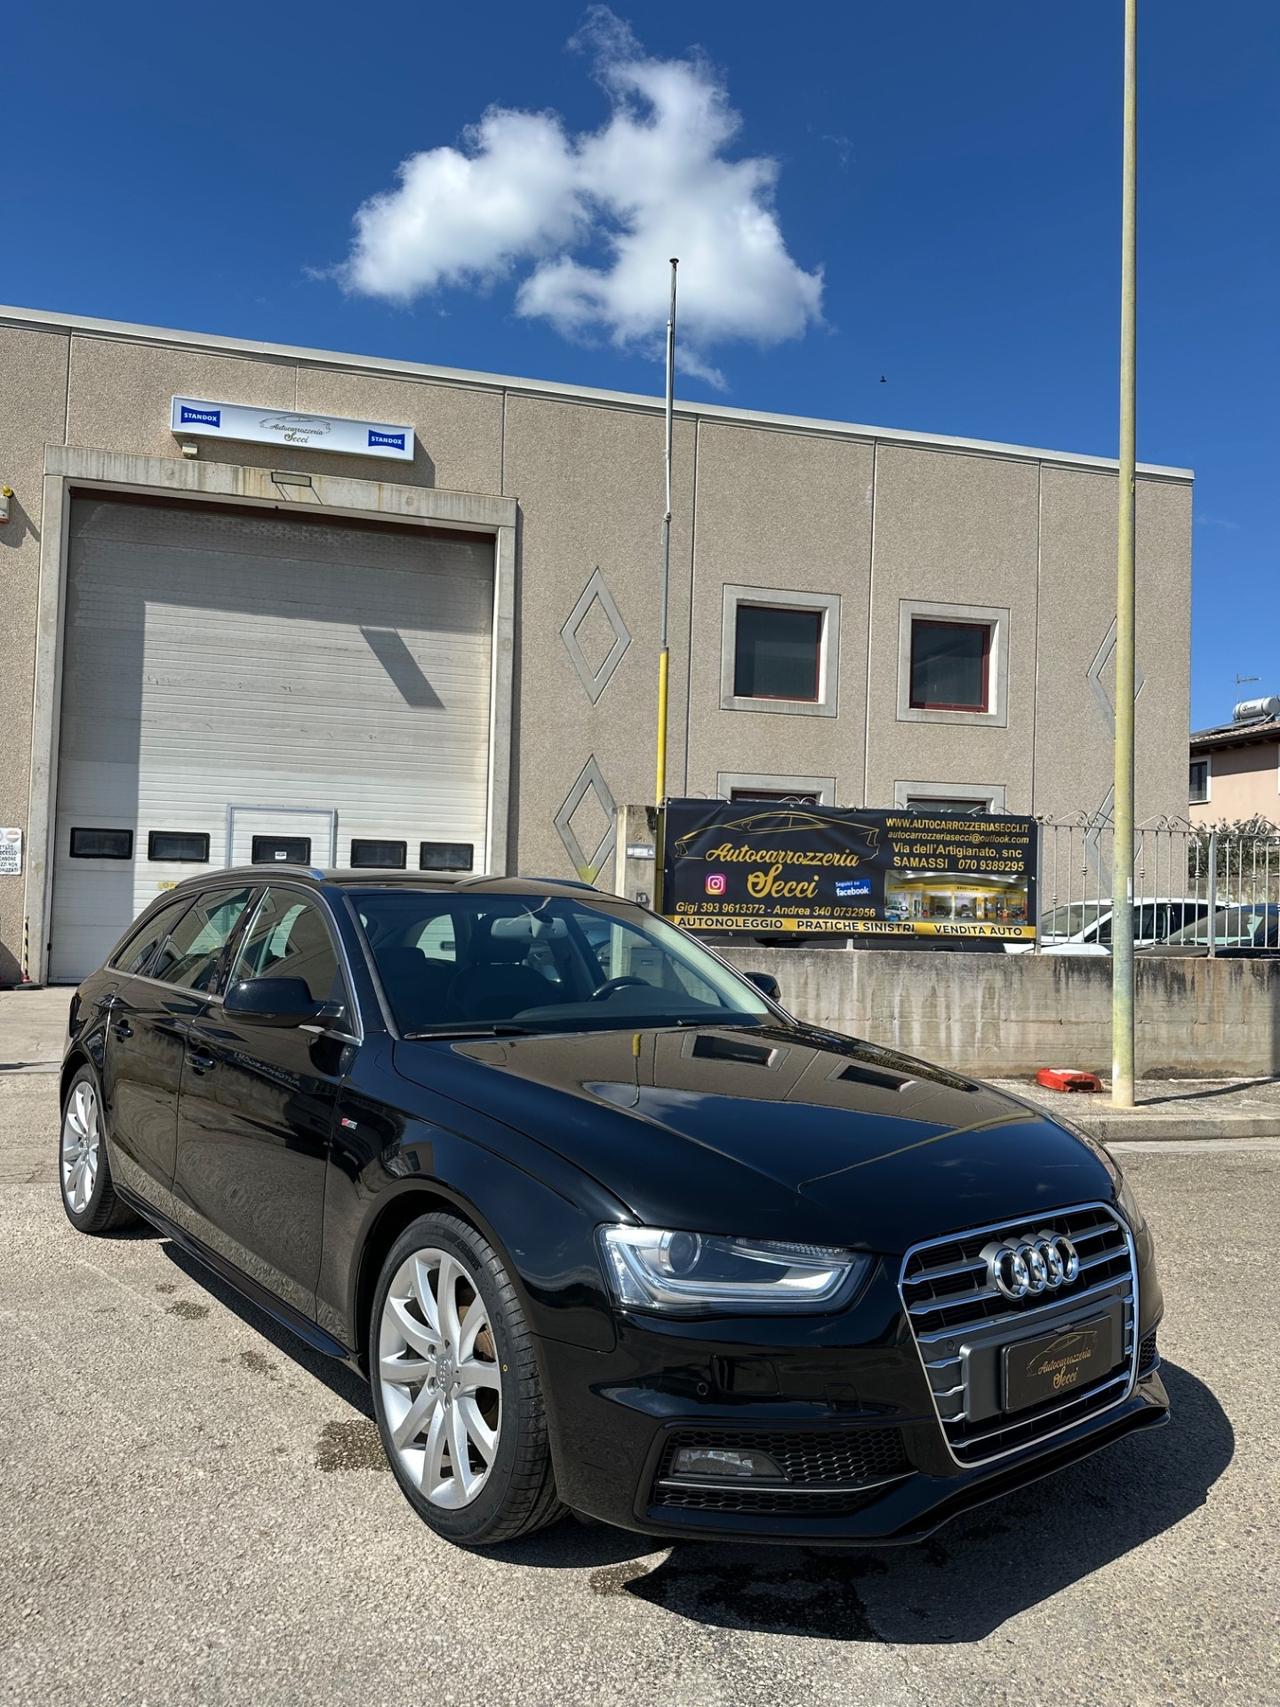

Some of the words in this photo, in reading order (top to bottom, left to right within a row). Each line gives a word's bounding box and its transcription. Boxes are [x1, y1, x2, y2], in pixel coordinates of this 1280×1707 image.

[183, 412, 217, 422] STANDOX
[371, 436, 402, 444] STANDOX
[885, 818, 1030, 833] WWW.AUTOCARROZZERIASECCI.IT
[705, 842, 860, 867] Autocarrozzeria
[892, 842, 910, 853] Via
[912, 843, 999, 859] dell'Artigianato,
[1001, 849, 1023, 858] snc
[893, 856, 949, 869] SAMASSI
[958, 859, 978, 870] 070
[979, 860, 1025, 872] 9389295
[747, 863, 819, 899] Secci
[836, 886, 869, 897] facebook
[676, 902, 698, 914] Gigi
[700, 902, 720, 913] 393
[721, 903, 766, 914] 9613372
[772, 905, 810, 916] Andrea
[812, 906, 832, 917] 340
[833, 906, 877, 918] 0732956
[678, 917, 784, 929] AUTONOLEGGIO
[796, 920, 860, 931] PRATICHE
[862, 922, 915, 932] SINISTRI
[933, 924, 986, 935] VENDITA
[989, 926, 1023, 937] AUTO
[1052, 1366, 1079, 1389] Secci
